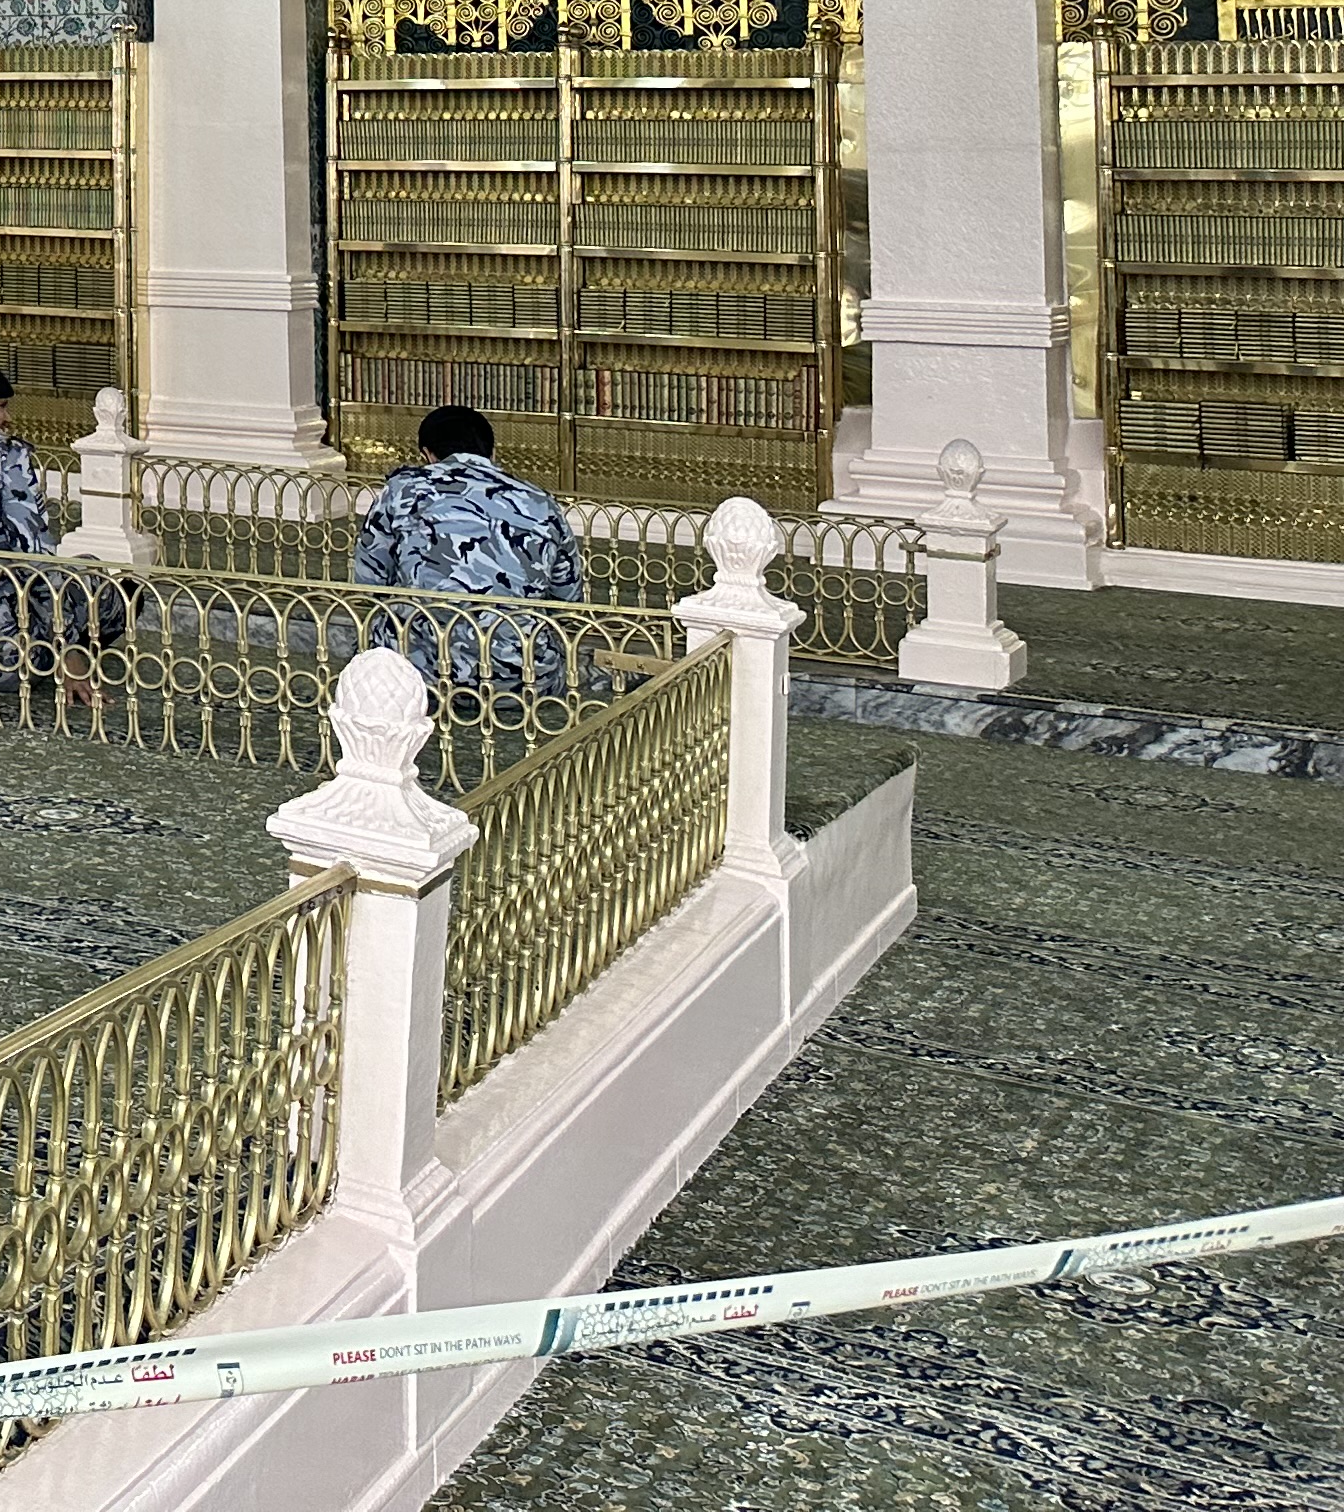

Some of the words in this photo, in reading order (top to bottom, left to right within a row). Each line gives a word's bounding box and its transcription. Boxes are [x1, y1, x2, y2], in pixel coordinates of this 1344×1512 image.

[882, 1285, 919, 1301] PLEASE
[949, 1279, 962, 1291] SIT
[973, 1275, 989, 1287] THE
[332, 1349, 376, 1366] PLEASE
[379, 1345, 411, 1360] DON'T
[414, 1342, 428, 1356] SIT
[430, 1341, 442, 1354] IN
[444, 1340, 463, 1352] THE
[465, 1337, 492, 1350] PATH
[493, 1333, 522, 1347] WAYS
